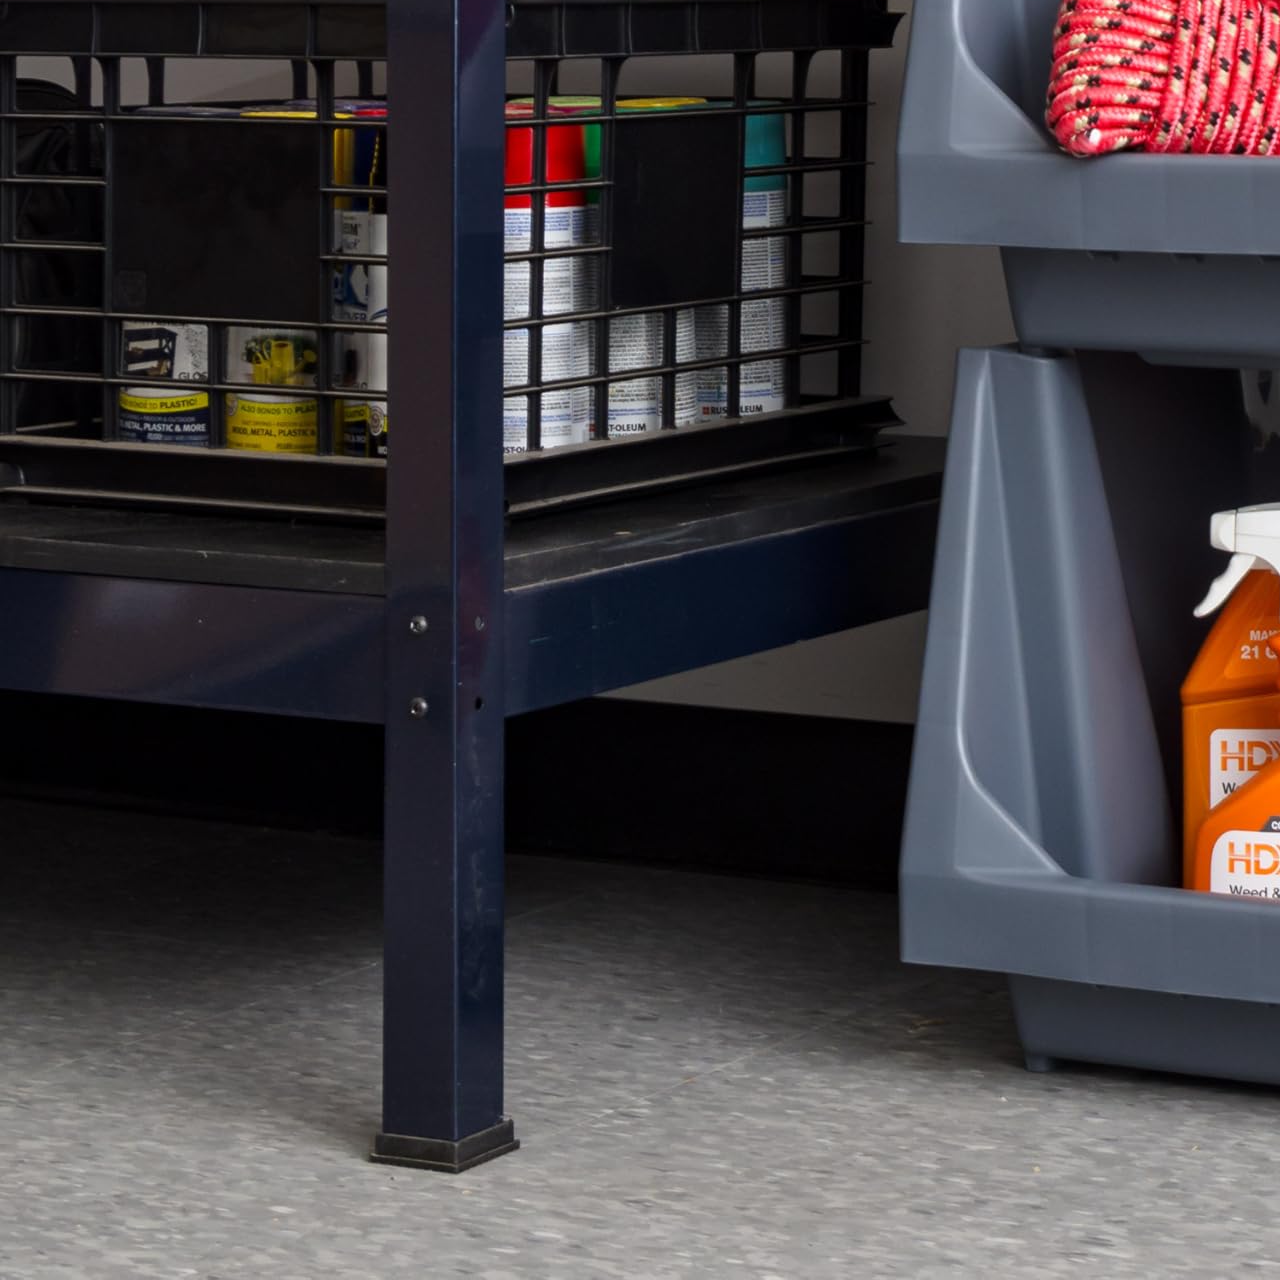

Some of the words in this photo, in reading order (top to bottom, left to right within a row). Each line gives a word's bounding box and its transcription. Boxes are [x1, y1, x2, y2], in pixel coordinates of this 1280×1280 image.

[283, 407, 292, 415] TO
[143, 423, 174, 432] PLASTIC
[182, 423, 206, 432] MORE
[251, 427, 277, 437] METAL,
[278, 428, 308, 437] PLASTIC
[1240, 645, 1259, 659] 21
[1229, 884, 1268, 898] Weed
[1271, 887, 1280, 898] &
